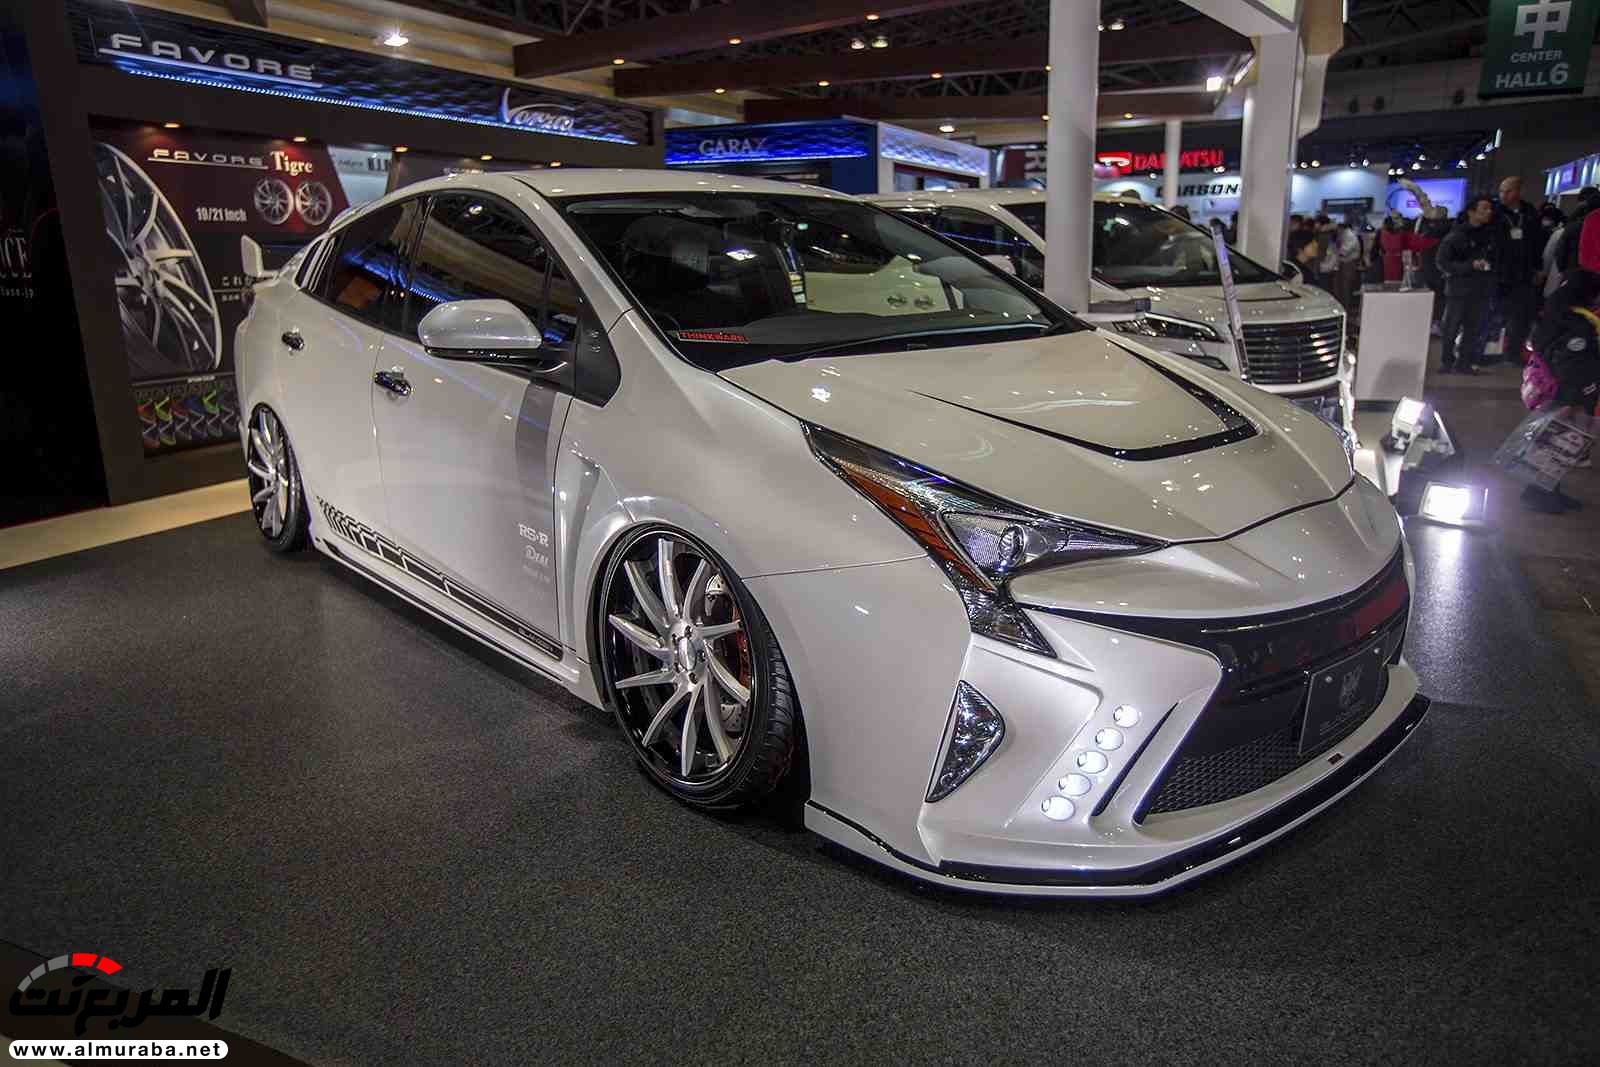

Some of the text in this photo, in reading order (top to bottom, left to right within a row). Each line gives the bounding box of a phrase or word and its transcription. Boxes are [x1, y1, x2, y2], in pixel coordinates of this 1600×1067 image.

[1514, 0, 1572, 49] 中
[110, 33, 313, 81] FAVORE
[1510, 50, 1563, 63] CENTER
[1495, 63, 1569, 88] HALL 6
[699, 137, 768, 156] GARAX
[152, 149, 264, 167] FAVORE
[270, 151, 313, 176] Tigre
[1134, 151, 1225, 170] DAIATSU
[1155, 184, 1239, 198] CRBON
